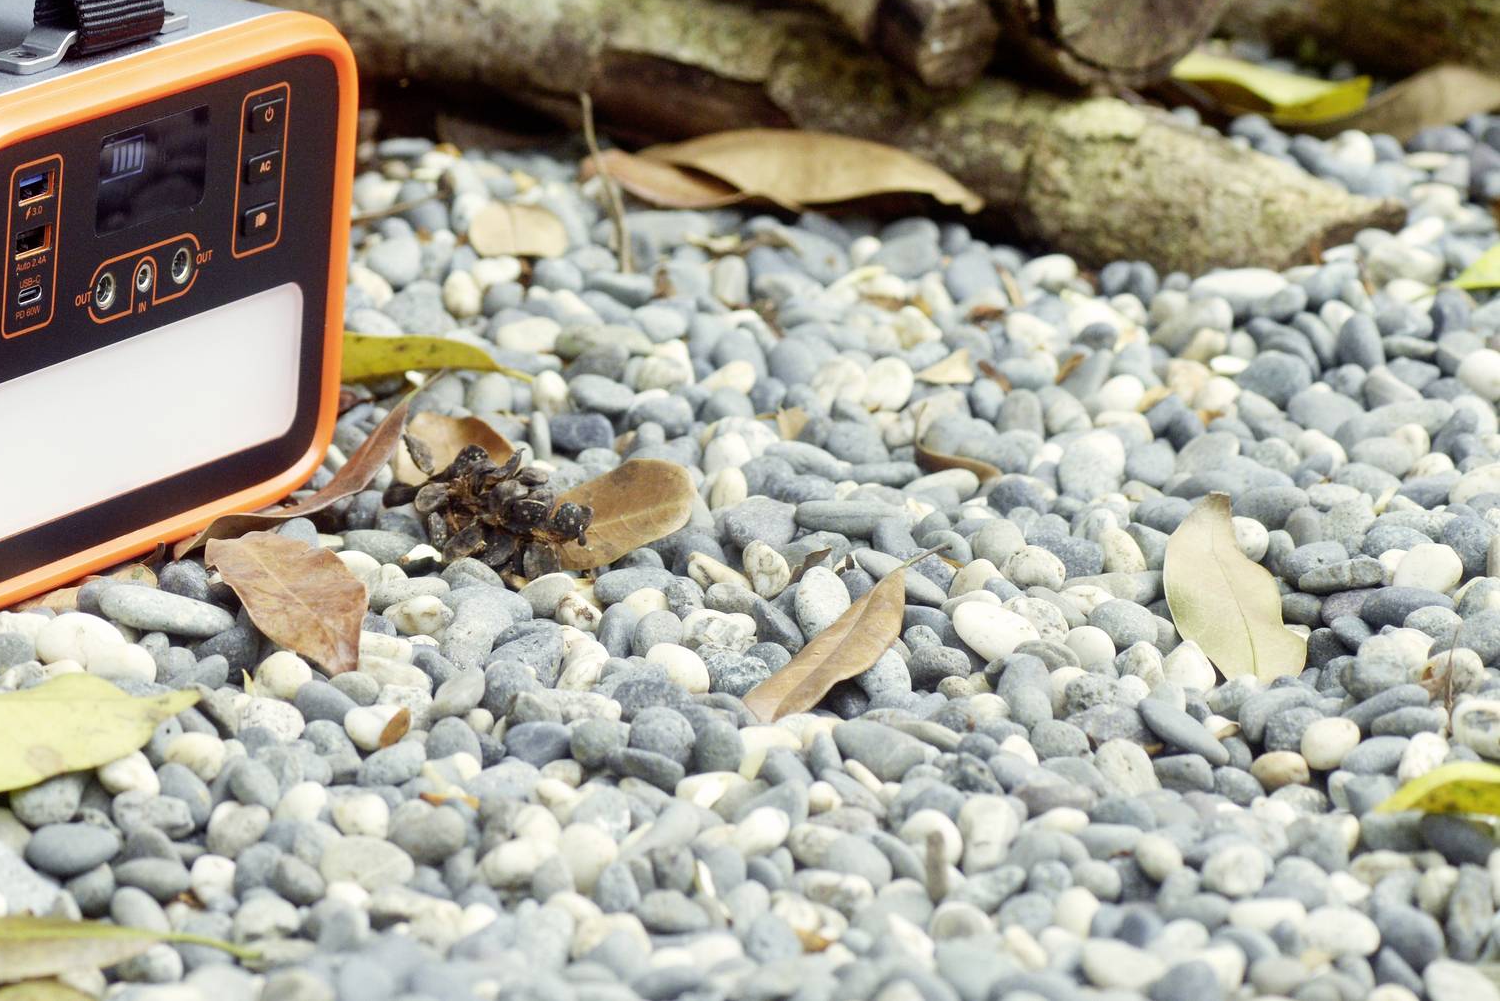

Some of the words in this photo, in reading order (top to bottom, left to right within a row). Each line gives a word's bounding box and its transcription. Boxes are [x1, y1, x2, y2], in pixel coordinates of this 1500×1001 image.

[259, 160, 272, 173] AC
[31, 205, 43, 216] 3.0
[196, 249, 213, 265] OUT
[19, 274, 41, 289] USB-C
[74, 290, 93, 307] OUT
[138, 301, 147, 314] IN
